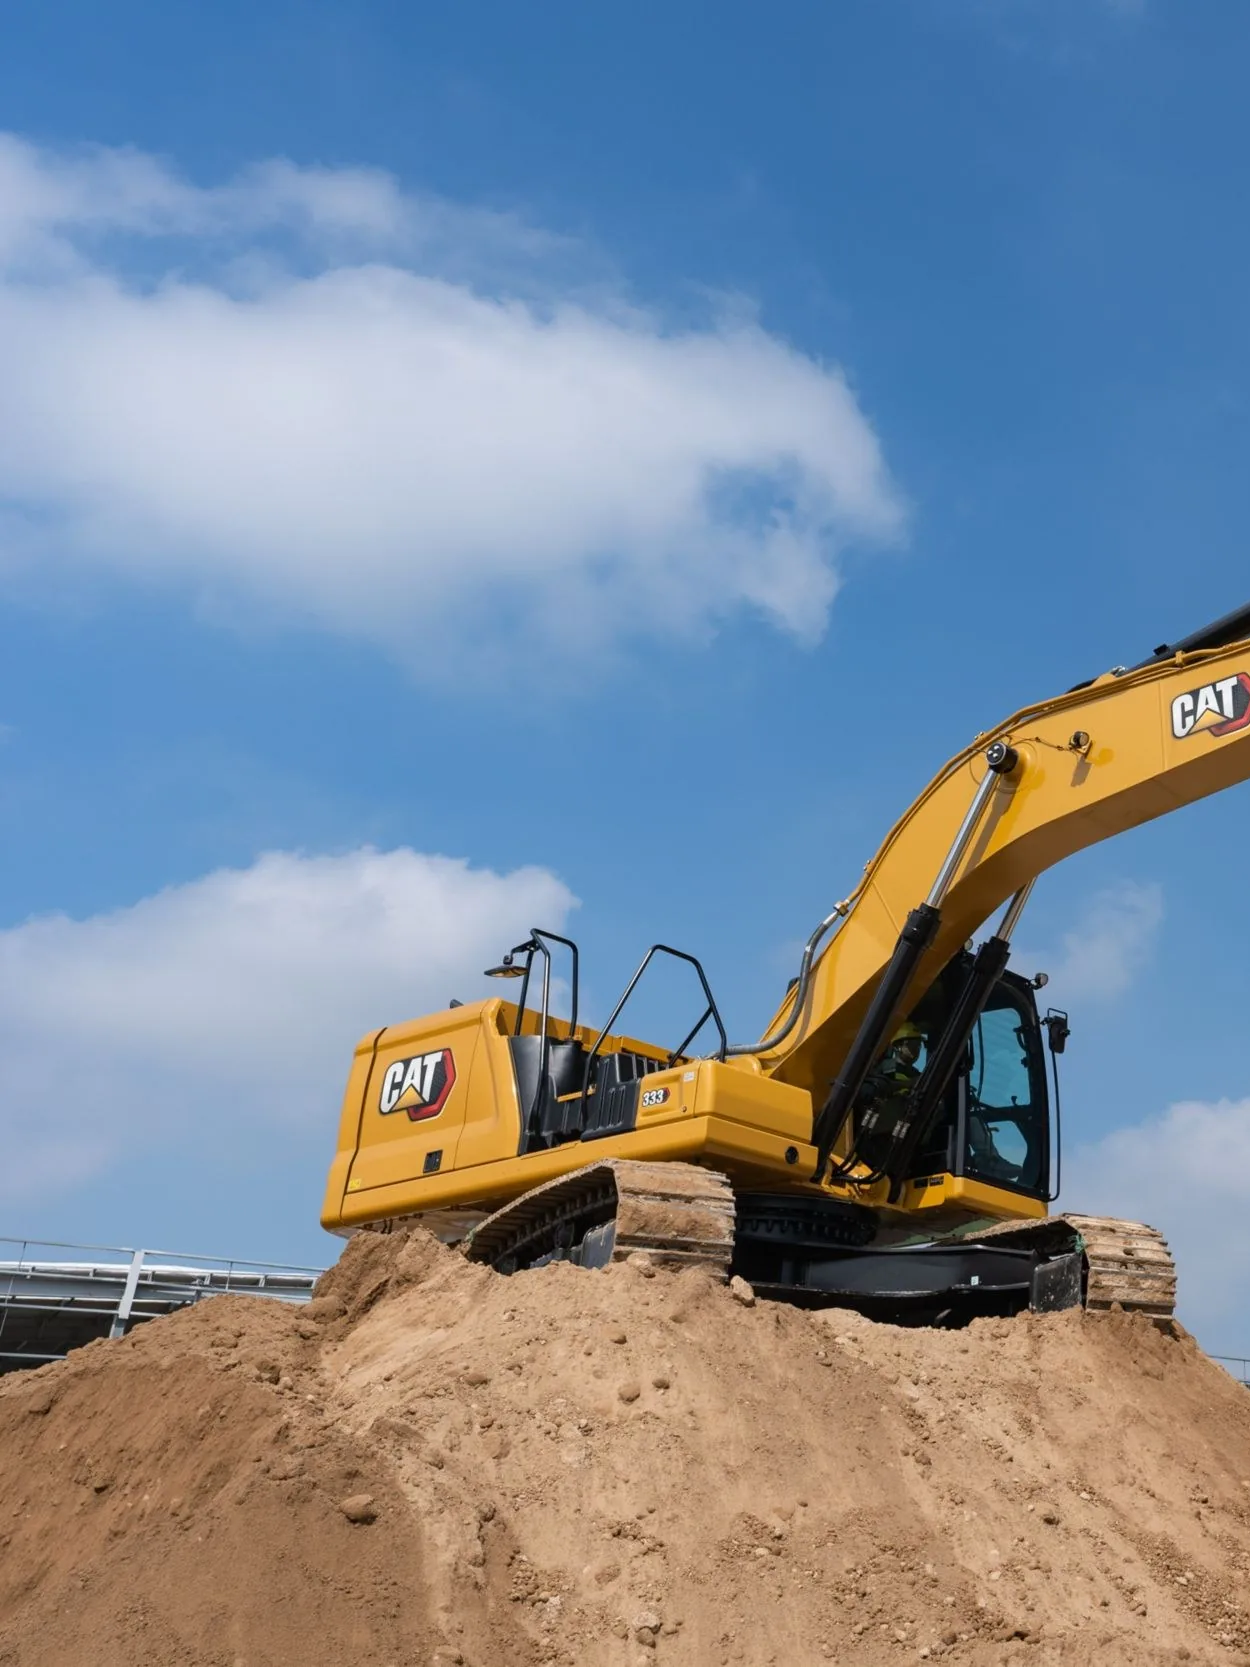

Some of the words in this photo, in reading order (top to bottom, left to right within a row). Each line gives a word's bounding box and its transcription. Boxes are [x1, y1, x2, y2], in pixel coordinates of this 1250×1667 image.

[1171, 675, 1238, 739] CAT
[379, 1050, 444, 1114] CAT
[642, 1088, 665, 1107] 333
